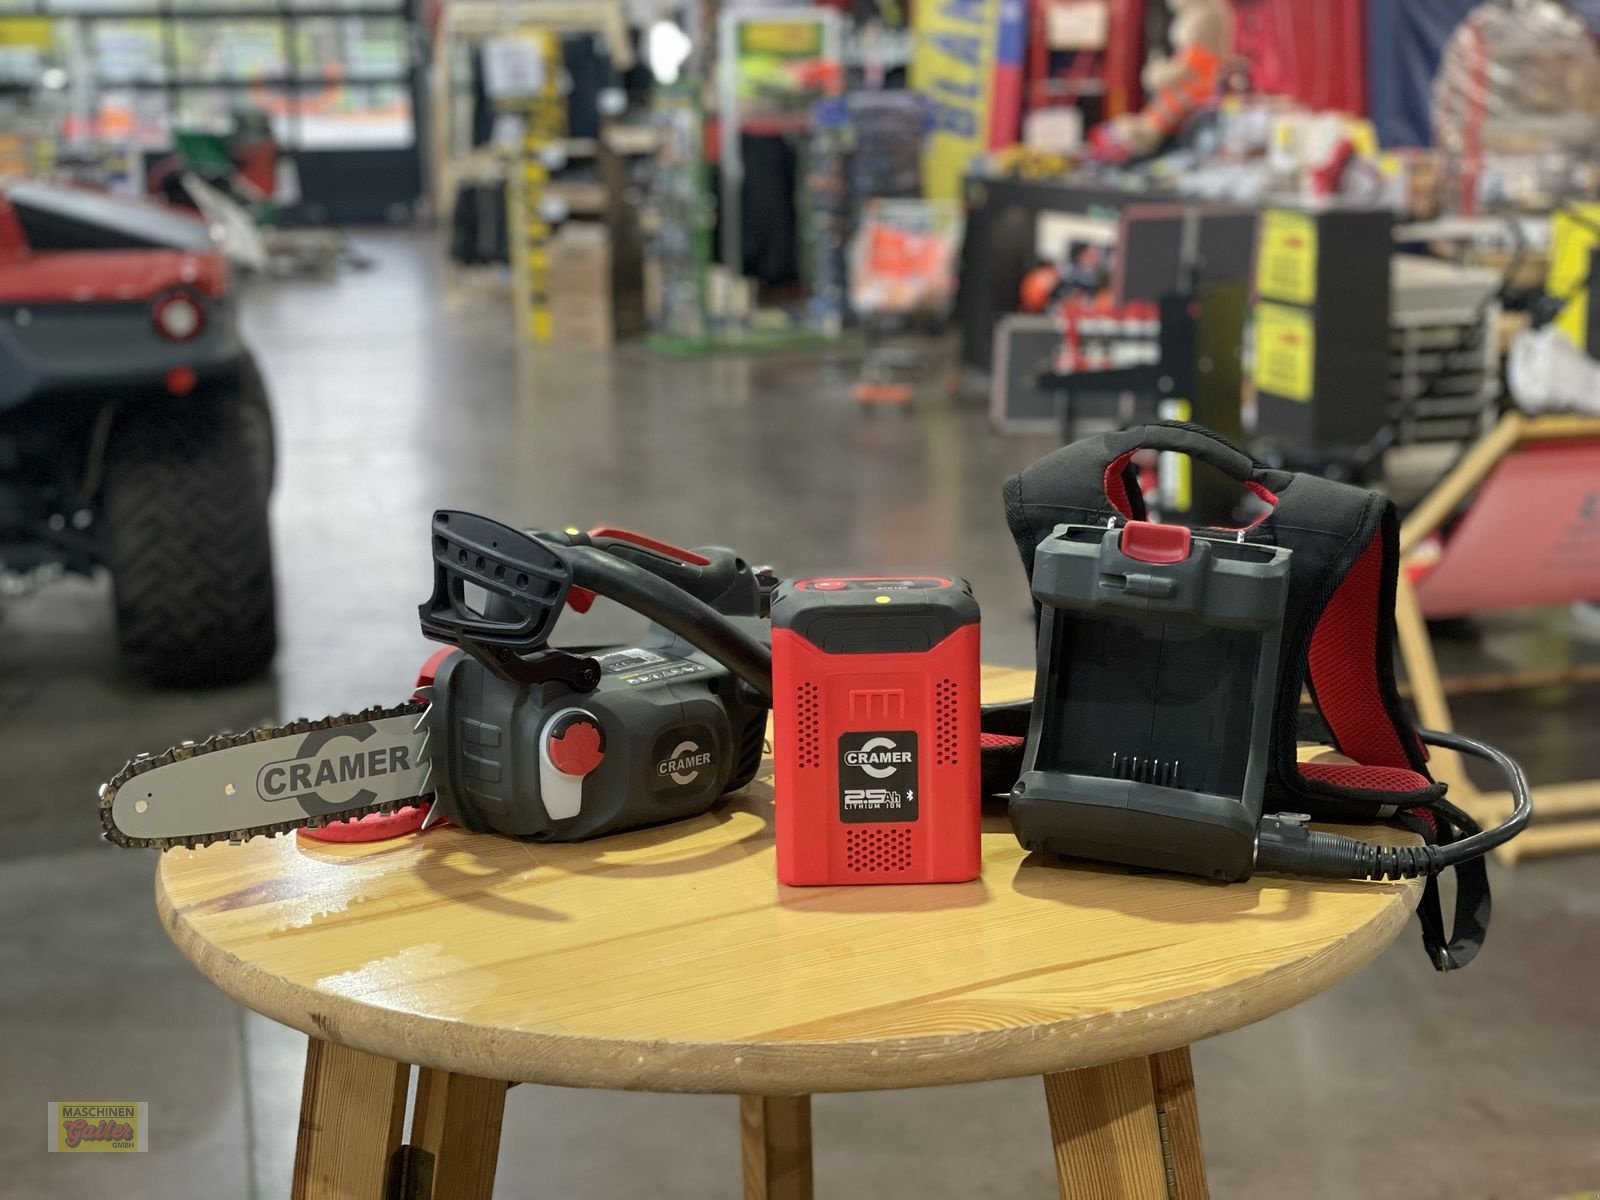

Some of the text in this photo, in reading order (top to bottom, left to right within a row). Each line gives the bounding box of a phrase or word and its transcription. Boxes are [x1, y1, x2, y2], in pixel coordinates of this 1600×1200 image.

[659, 752, 711, 774] CRAMER
[847, 751, 912, 764] CRAMER
[263, 745, 411, 796] CRAMER
